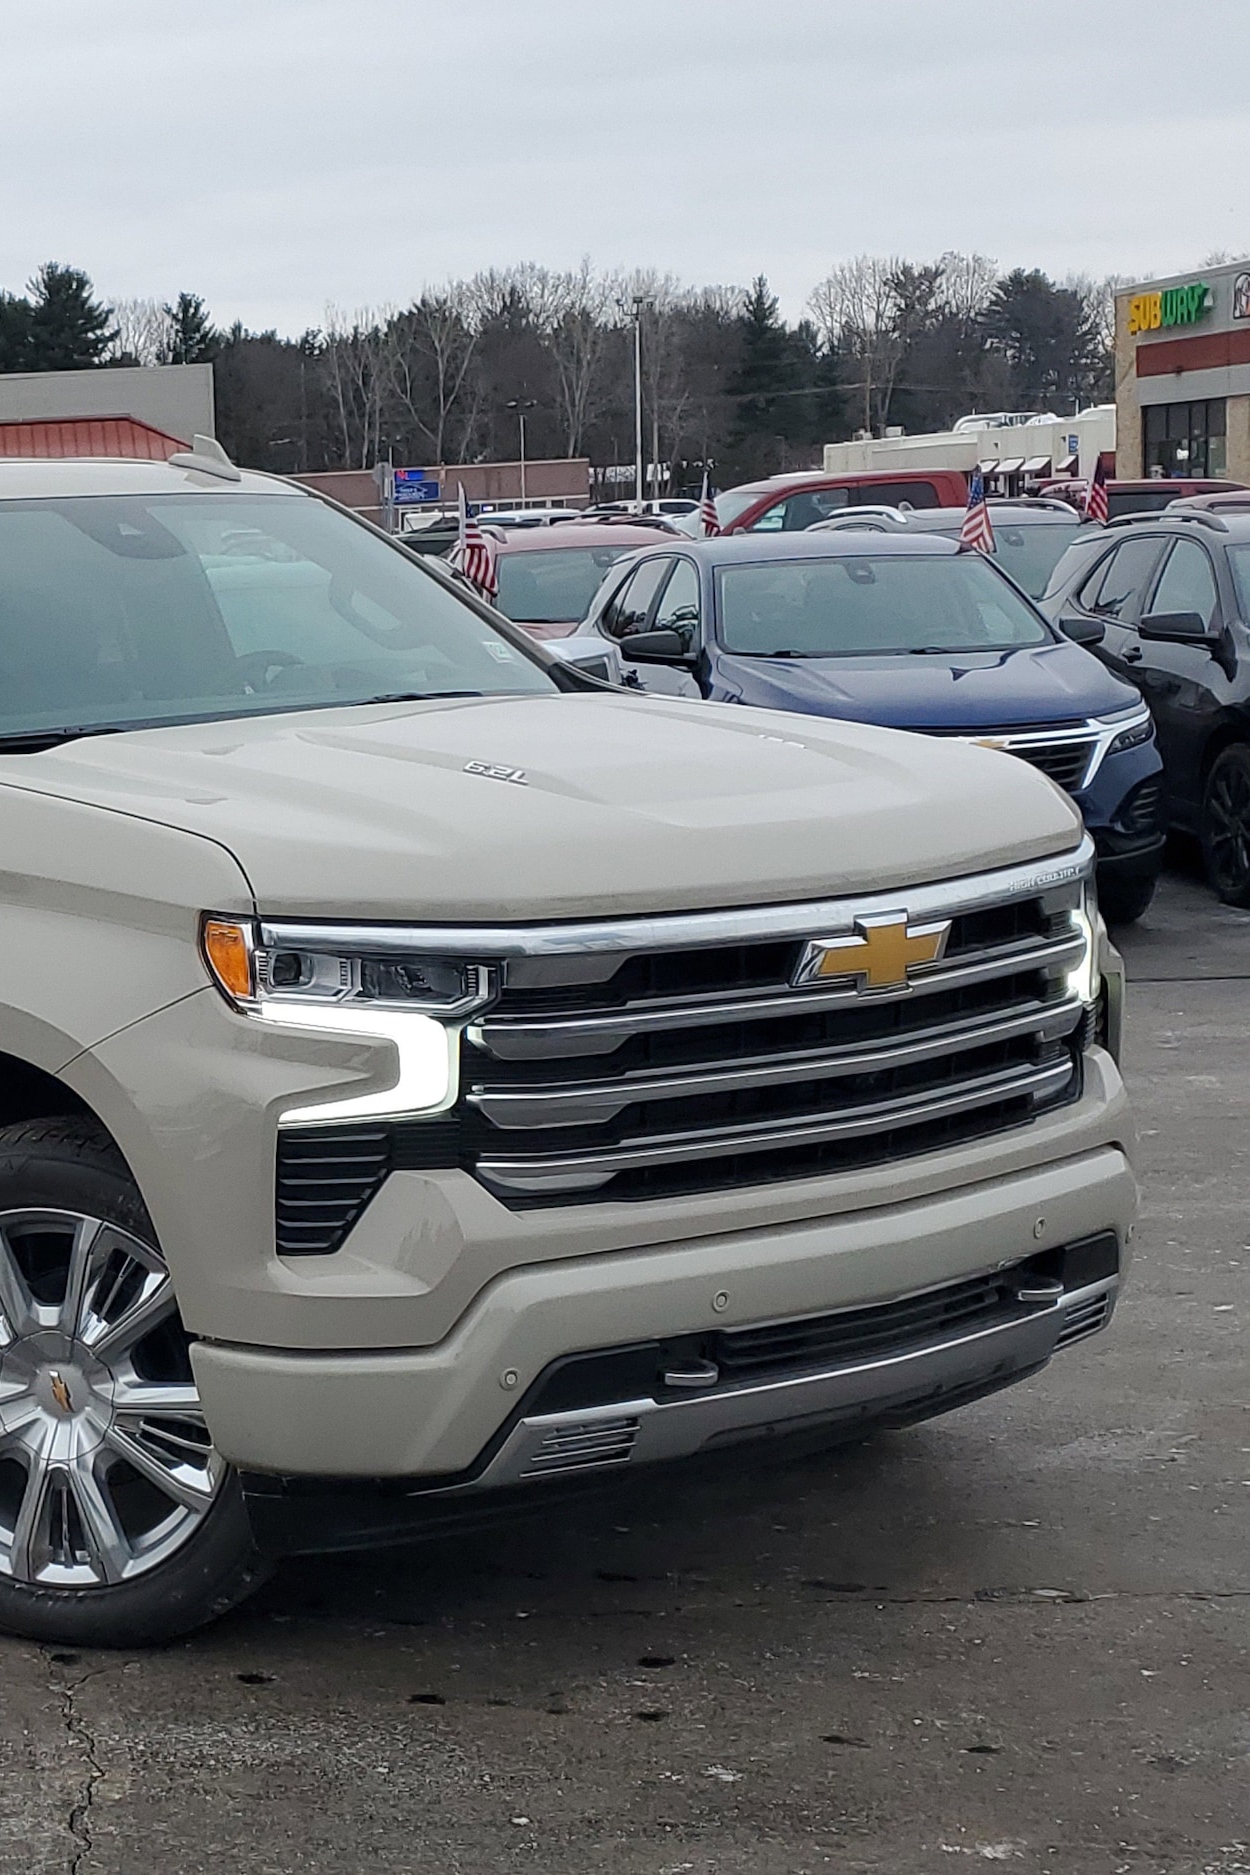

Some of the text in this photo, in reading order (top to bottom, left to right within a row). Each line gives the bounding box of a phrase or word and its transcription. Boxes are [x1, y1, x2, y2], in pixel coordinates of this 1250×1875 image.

[1128, 281, 1211, 335] SUBWAY
[463, 760, 529, 785] 6.2L
[1008, 867, 1080, 891] HIGH COUNTRY
